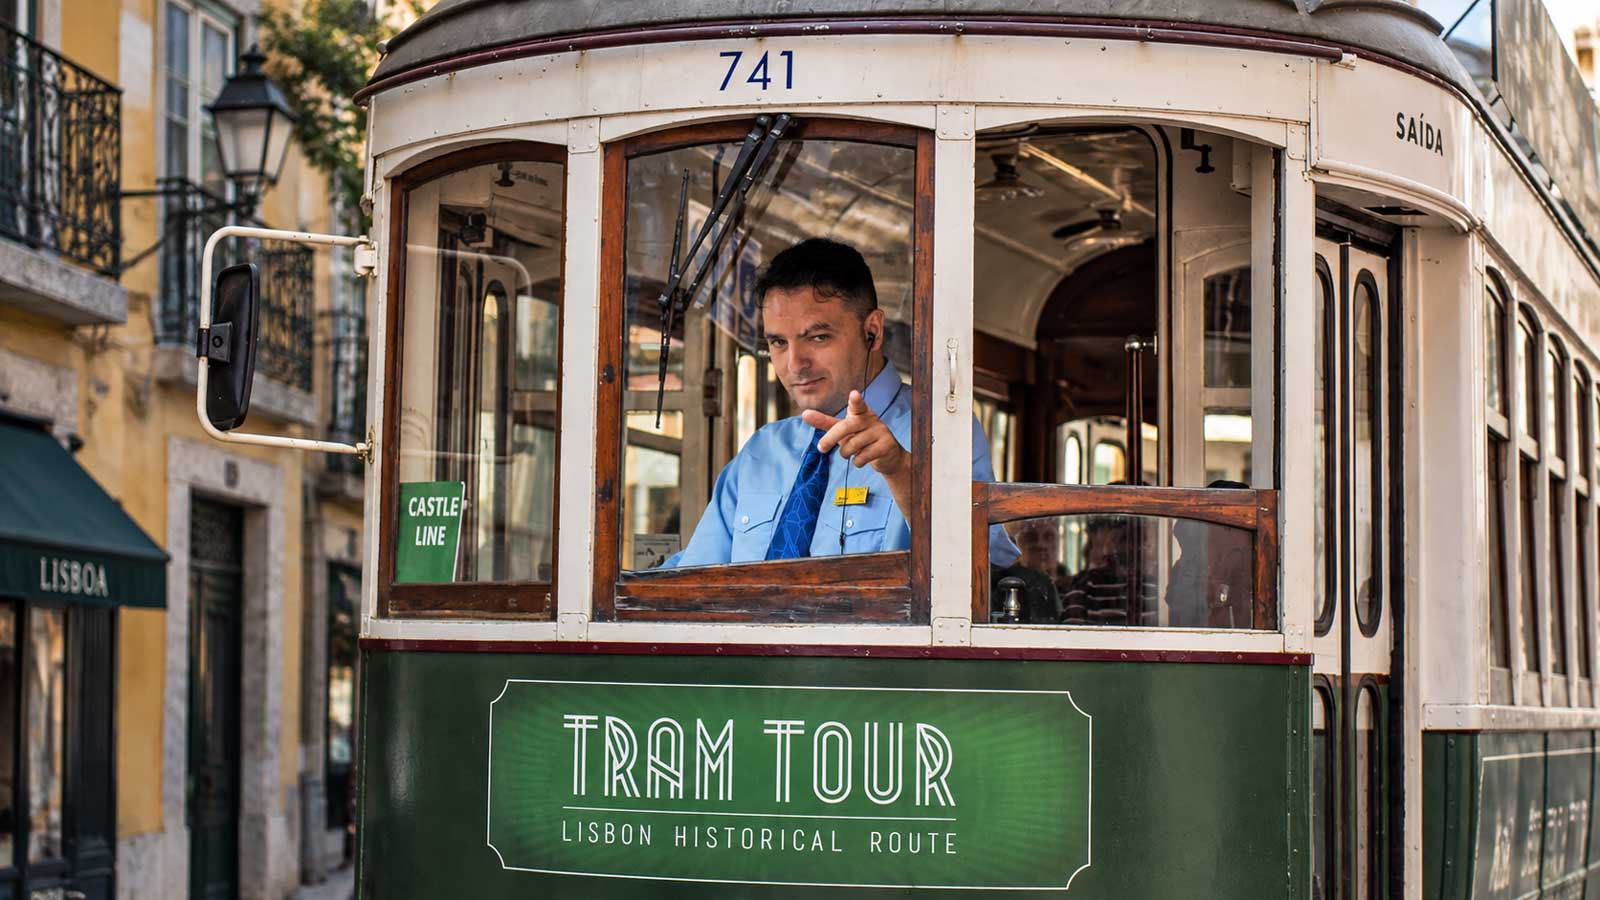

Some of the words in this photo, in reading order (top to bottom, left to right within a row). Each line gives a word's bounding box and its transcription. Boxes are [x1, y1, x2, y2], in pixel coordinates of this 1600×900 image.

[719, 50, 794, 91] 741
[1396, 112, 1443, 156] SAÍDA
[408, 496, 460, 517] CASTLE
[415, 525, 447, 546] LINE
[40, 557, 109, 597] LISBOA
[563, 714, 734, 801] TRAM
[763, 720, 956, 807] TOUR
[562, 820, 652, 846] LISBON
[674, 826, 843, 852] HISTORICAL
[870, 831, 957, 854] ROUTE
